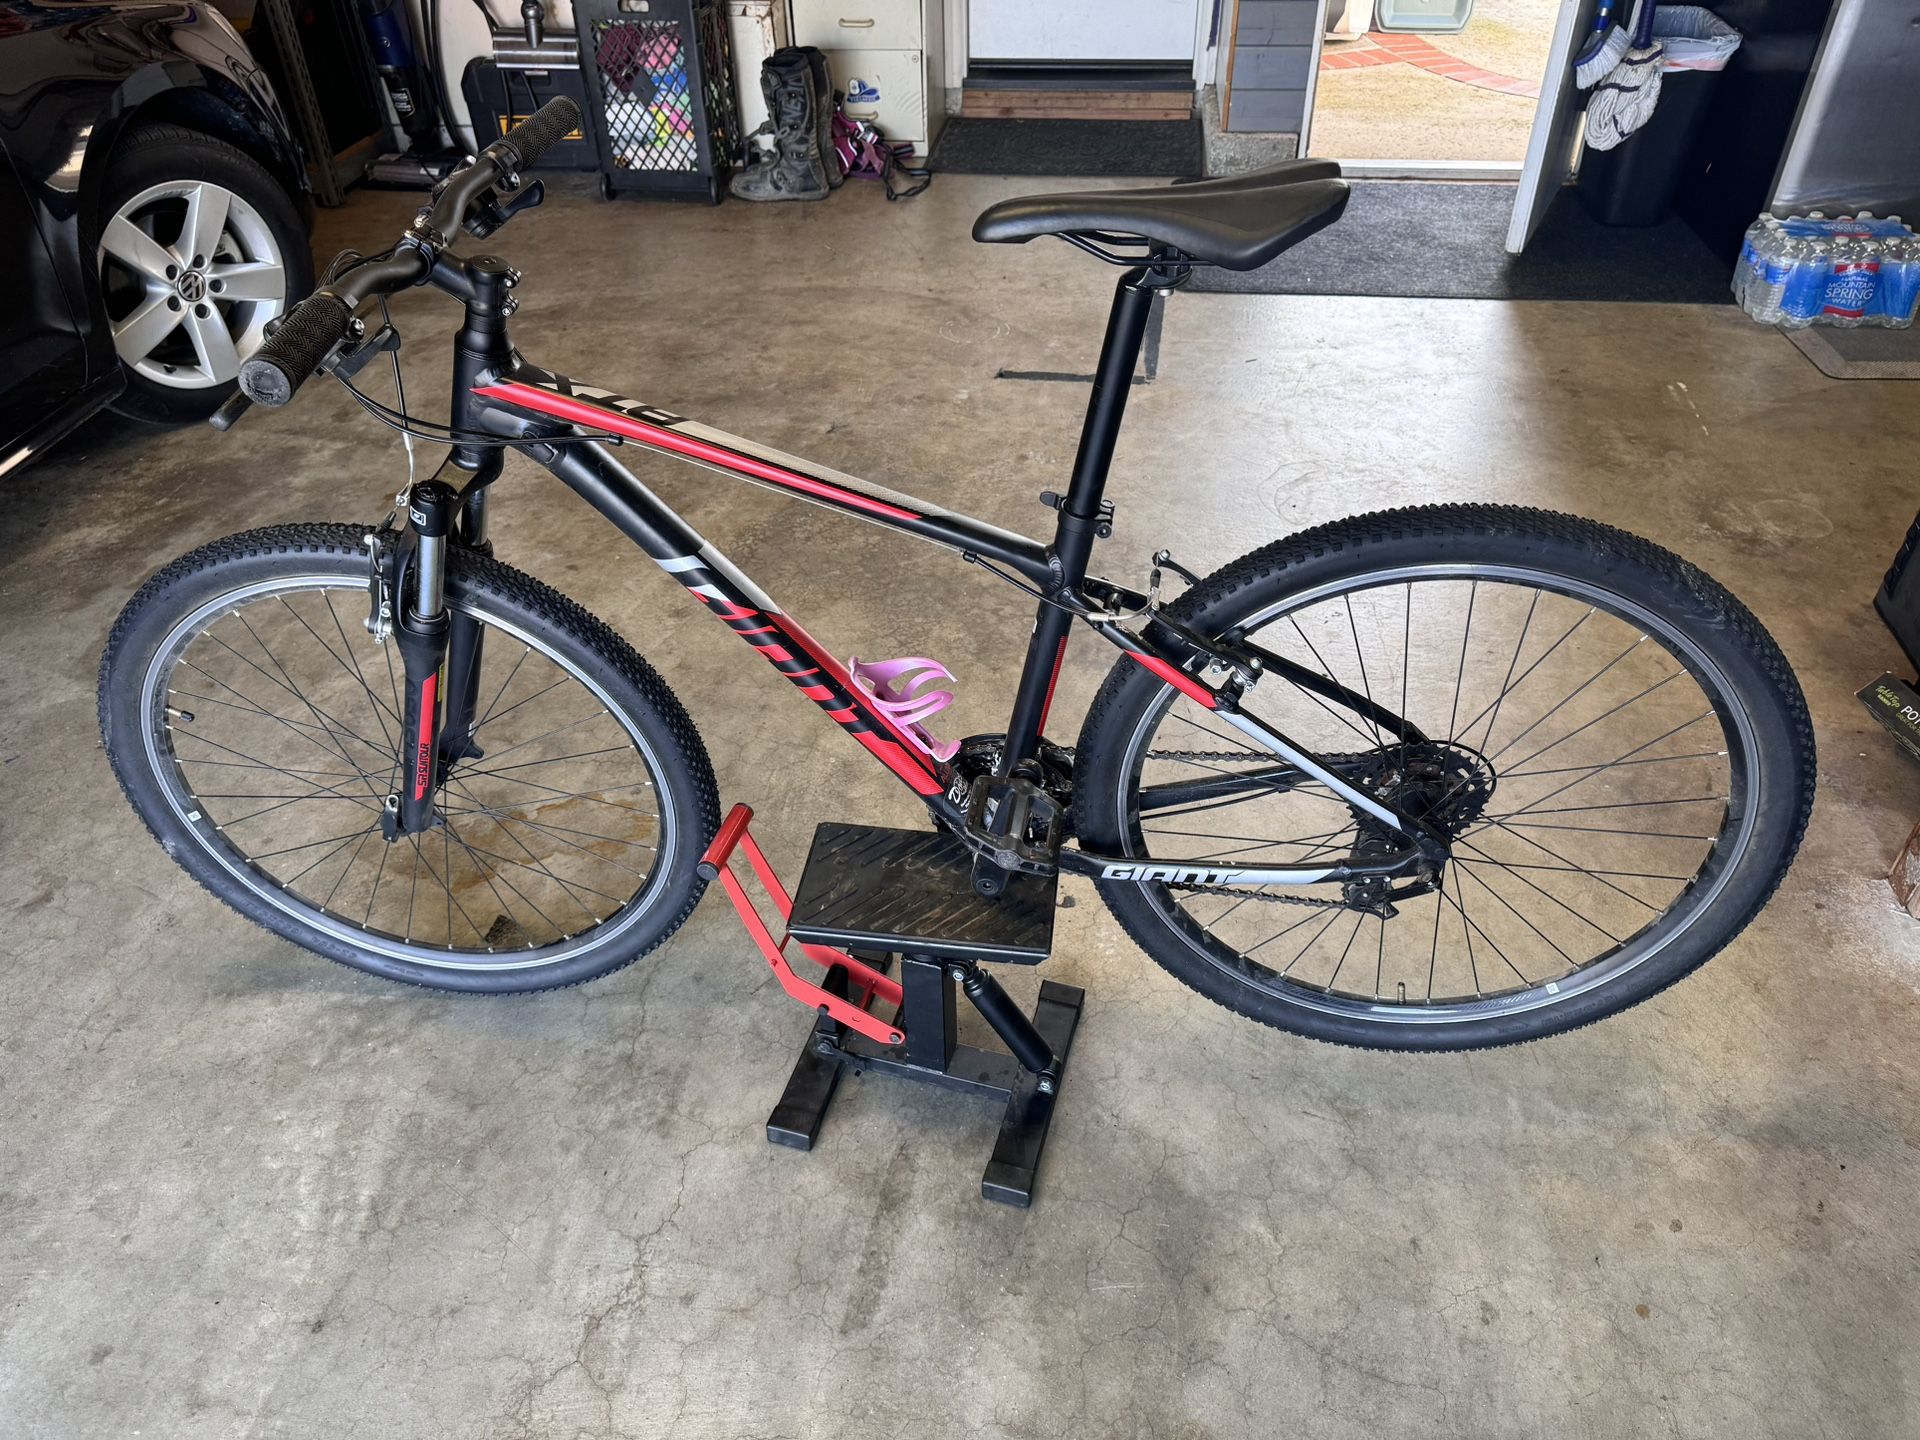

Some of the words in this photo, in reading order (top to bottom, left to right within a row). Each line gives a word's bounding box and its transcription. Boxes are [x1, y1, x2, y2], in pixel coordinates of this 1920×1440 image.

[1827, 281, 1876, 289] MOUNTAIN
[1824, 287, 1873, 300] SPRING
[1101, 864, 1245, 884] GIANT
